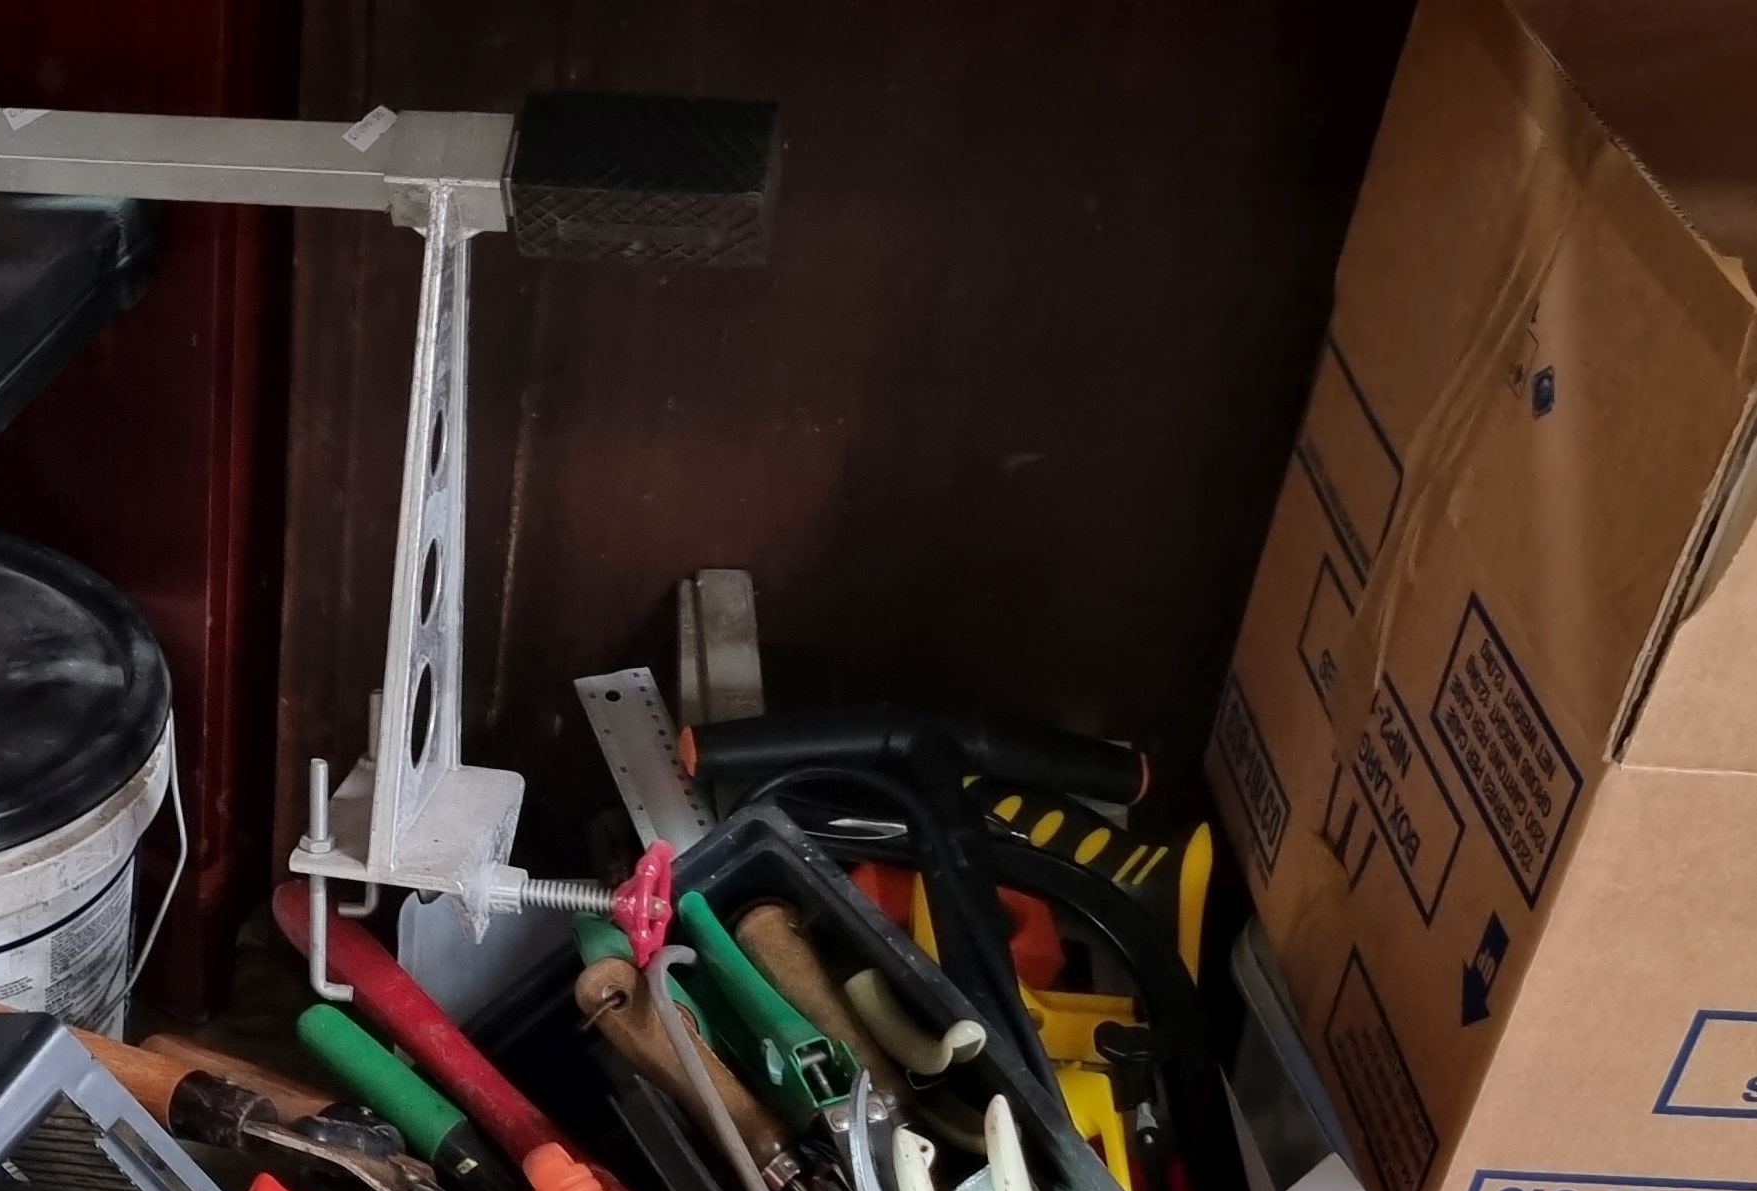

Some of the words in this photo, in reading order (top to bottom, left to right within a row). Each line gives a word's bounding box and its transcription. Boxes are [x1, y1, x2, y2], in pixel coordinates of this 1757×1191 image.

[1446, 705, 1466, 752] CASE
[1451, 673, 1472, 720] CASE
[1504, 685, 1537, 750] WEIGHT
[1489, 701, 1520, 765] WEIGHT
[1356, 735, 1394, 808] LARG
[1384, 803, 1422, 868] BOX
